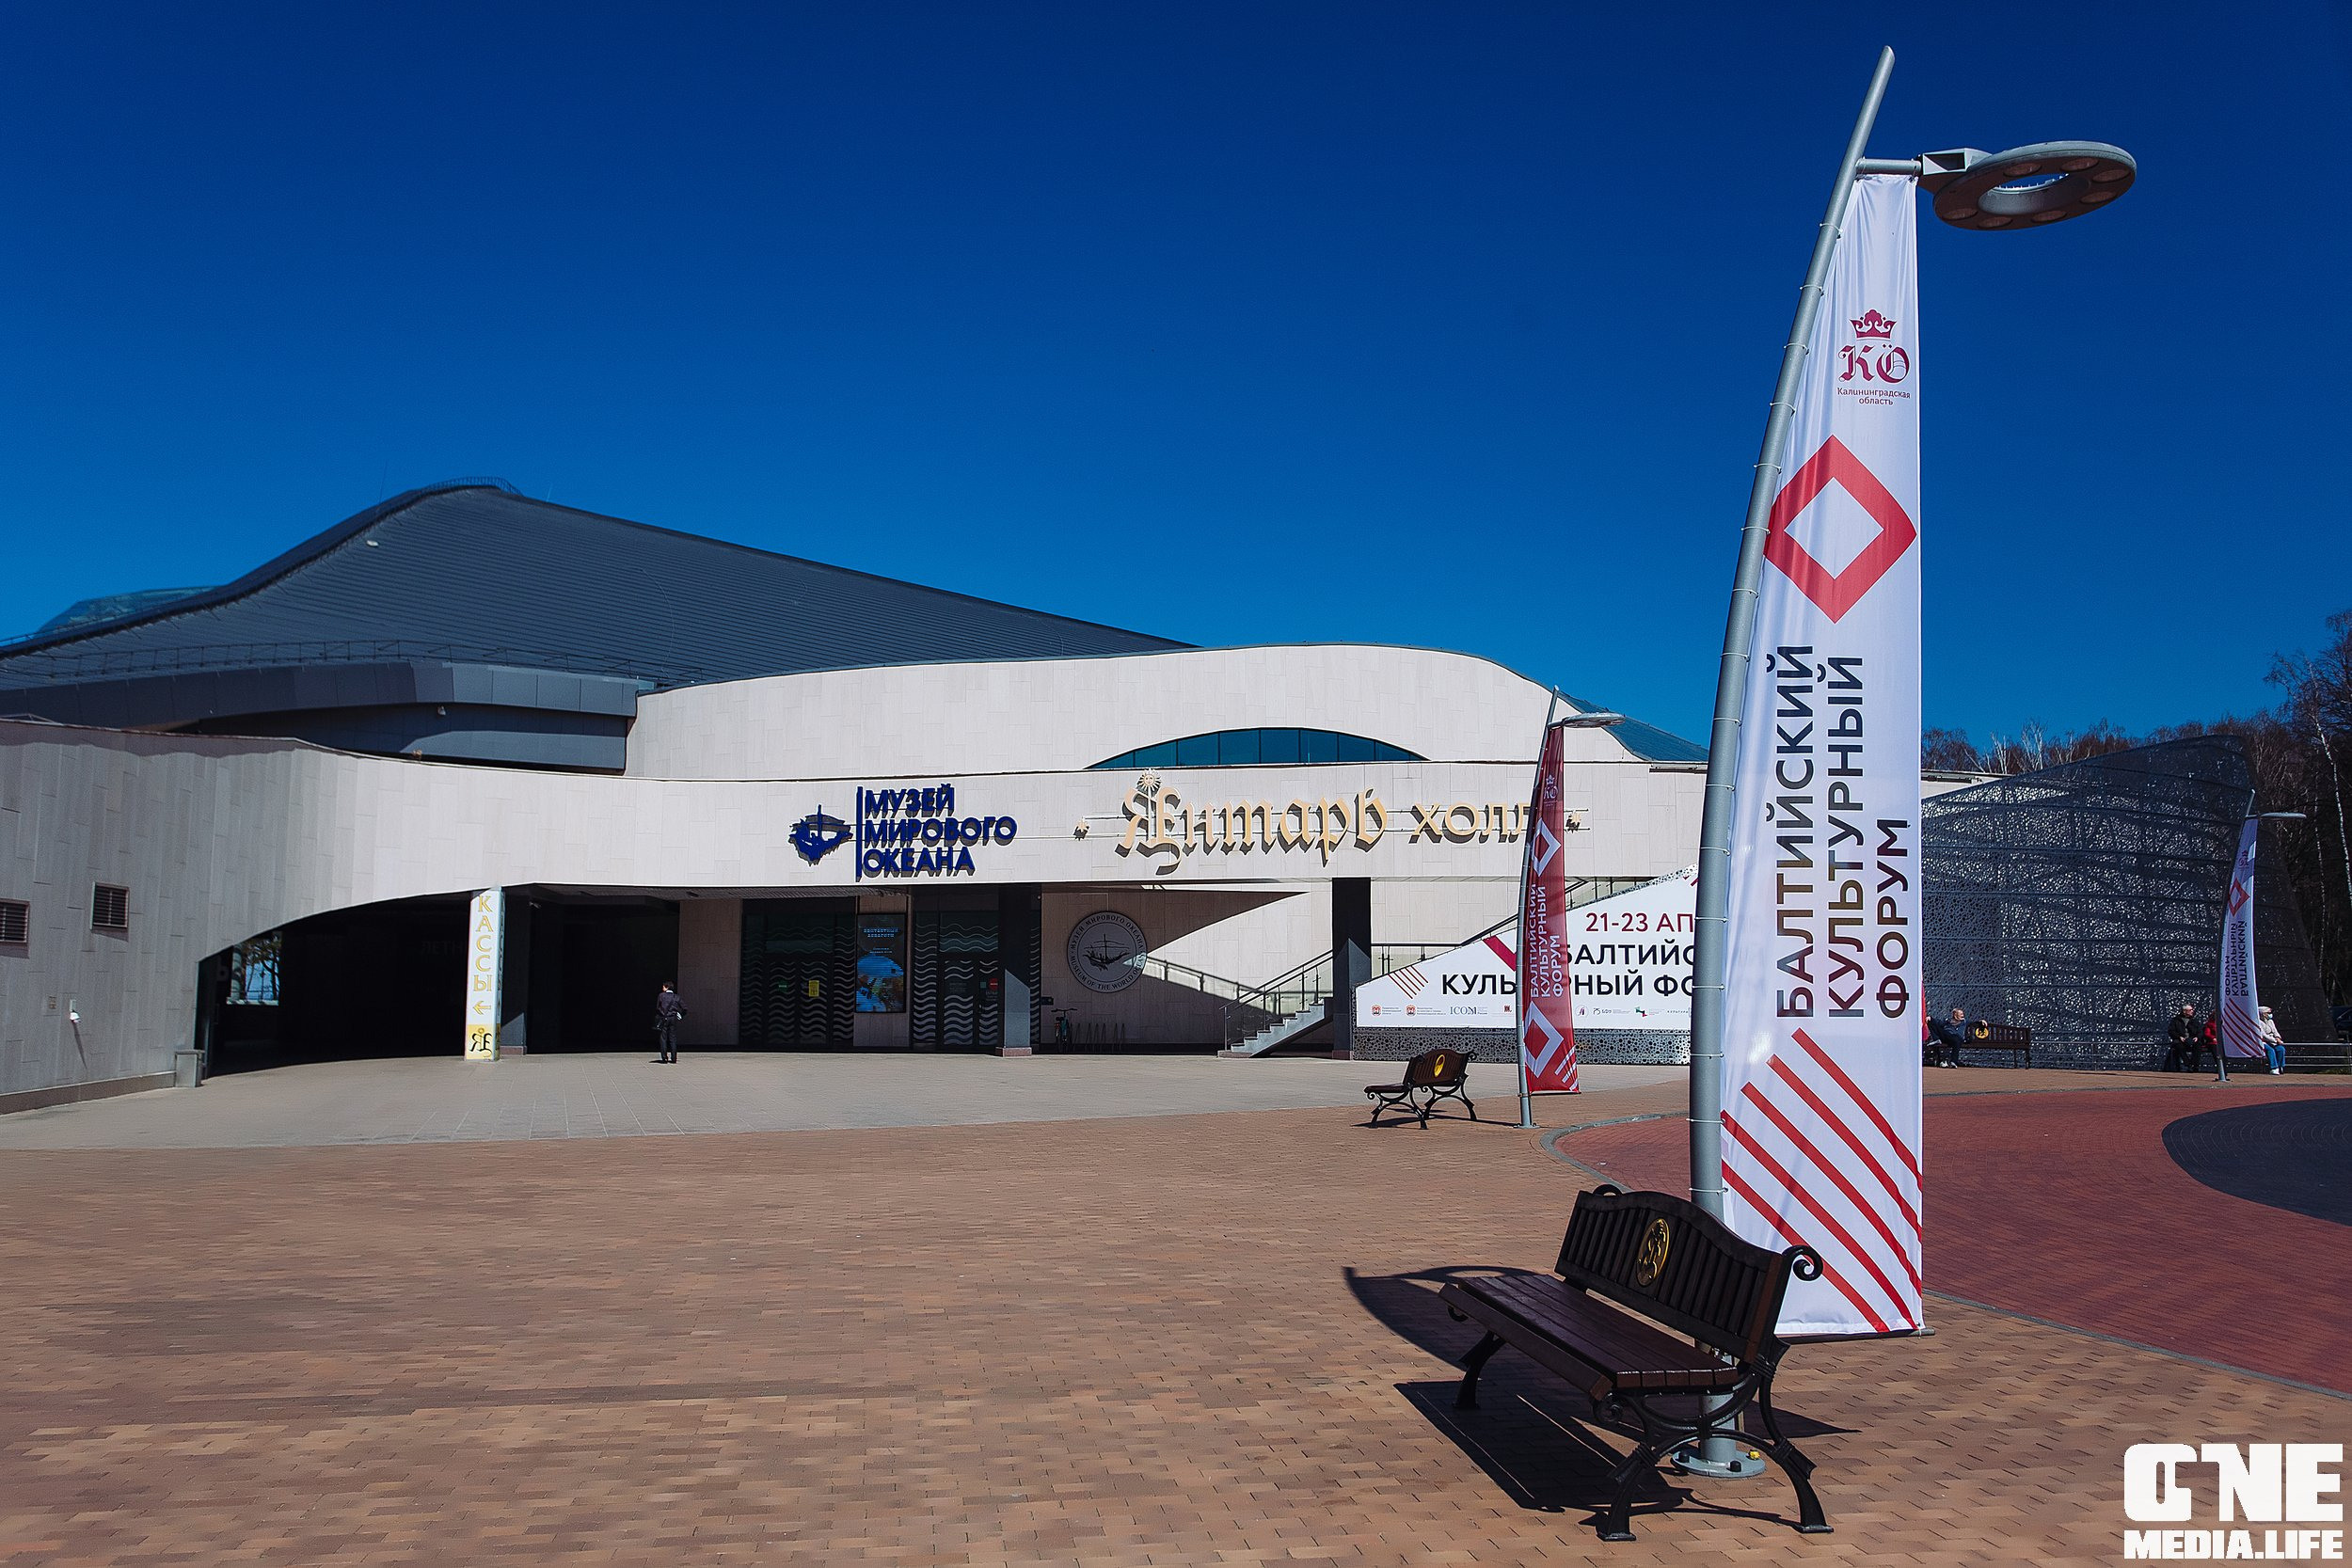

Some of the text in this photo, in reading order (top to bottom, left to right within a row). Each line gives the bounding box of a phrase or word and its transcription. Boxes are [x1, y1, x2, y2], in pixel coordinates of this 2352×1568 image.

[1836, 387, 1911, 399] Калининградская
[1858, 396, 1894, 405] область
[864, 783, 955, 816] МУЗЕЙ
[864, 816, 1017, 847] МИРОВОГО
[1116, 787, 1388, 871] Янтарь
[1766, 645, 1815, 1018] БАЛТИЙСКИЙ
[1817, 657, 1864, 1018] КУЛЬТУРНЫЙ
[863, 847, 976, 877] ОКЕАНА
[1086, 915, 1125, 926] МИРОВОГО
[1126, 923, 1144, 949] ОКЕАНА
[1585, 912, 1648, 932] 21-23
[1875, 819, 1910, 1018] ФОРУМ
[473, 895, 493, 992] КАССЫ
[1536, 886, 1550, 998] КУЛЬТУРНЫЙ
[1070, 956, 1088, 981] MUSEUM
[1112, 975, 1134, 990] WORLD
[1549, 934, 1564, 997] ФОРУМ
[1450, 1006, 1477, 1015] ICOM
